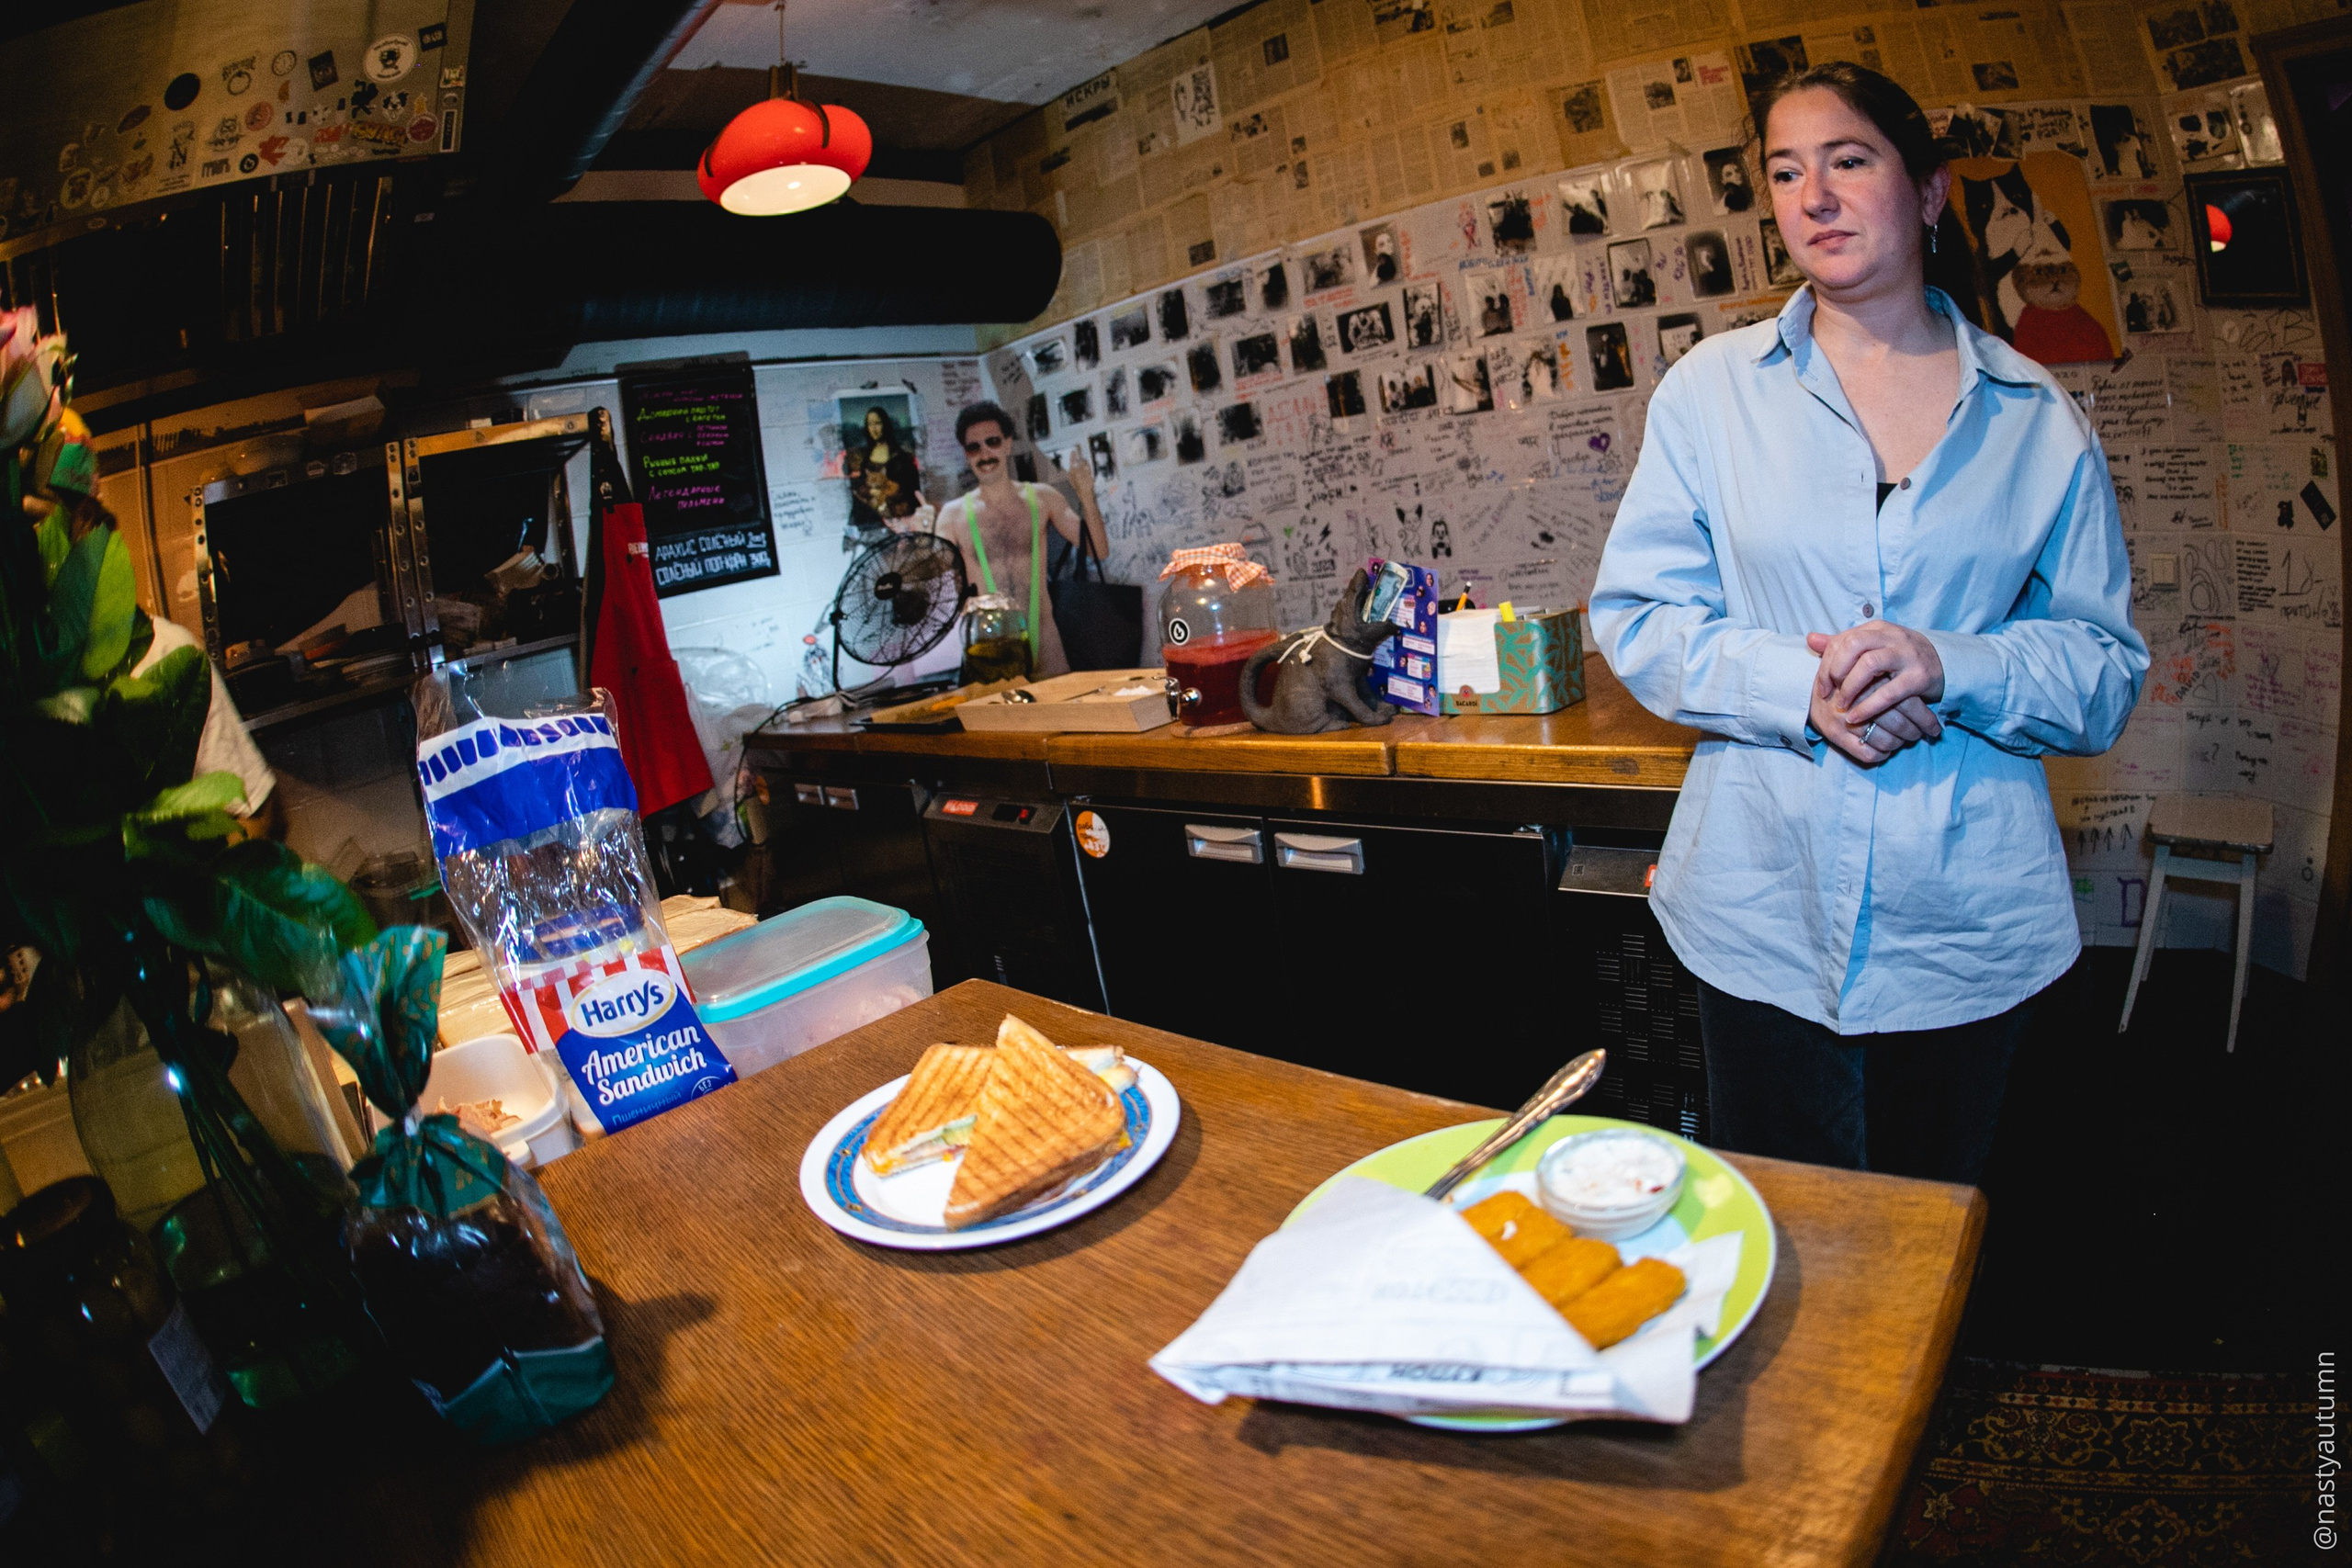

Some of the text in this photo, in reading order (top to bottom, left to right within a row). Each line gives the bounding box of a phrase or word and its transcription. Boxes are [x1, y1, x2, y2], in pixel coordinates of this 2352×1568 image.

[581, 980, 664, 1028] Harrys
[582, 1025, 701, 1085] American
[597, 1049, 707, 1106] Sandwich
[612, 1089, 683, 1126] Пшеничный
[697, 1079, 711, 1092] БЕЗ
